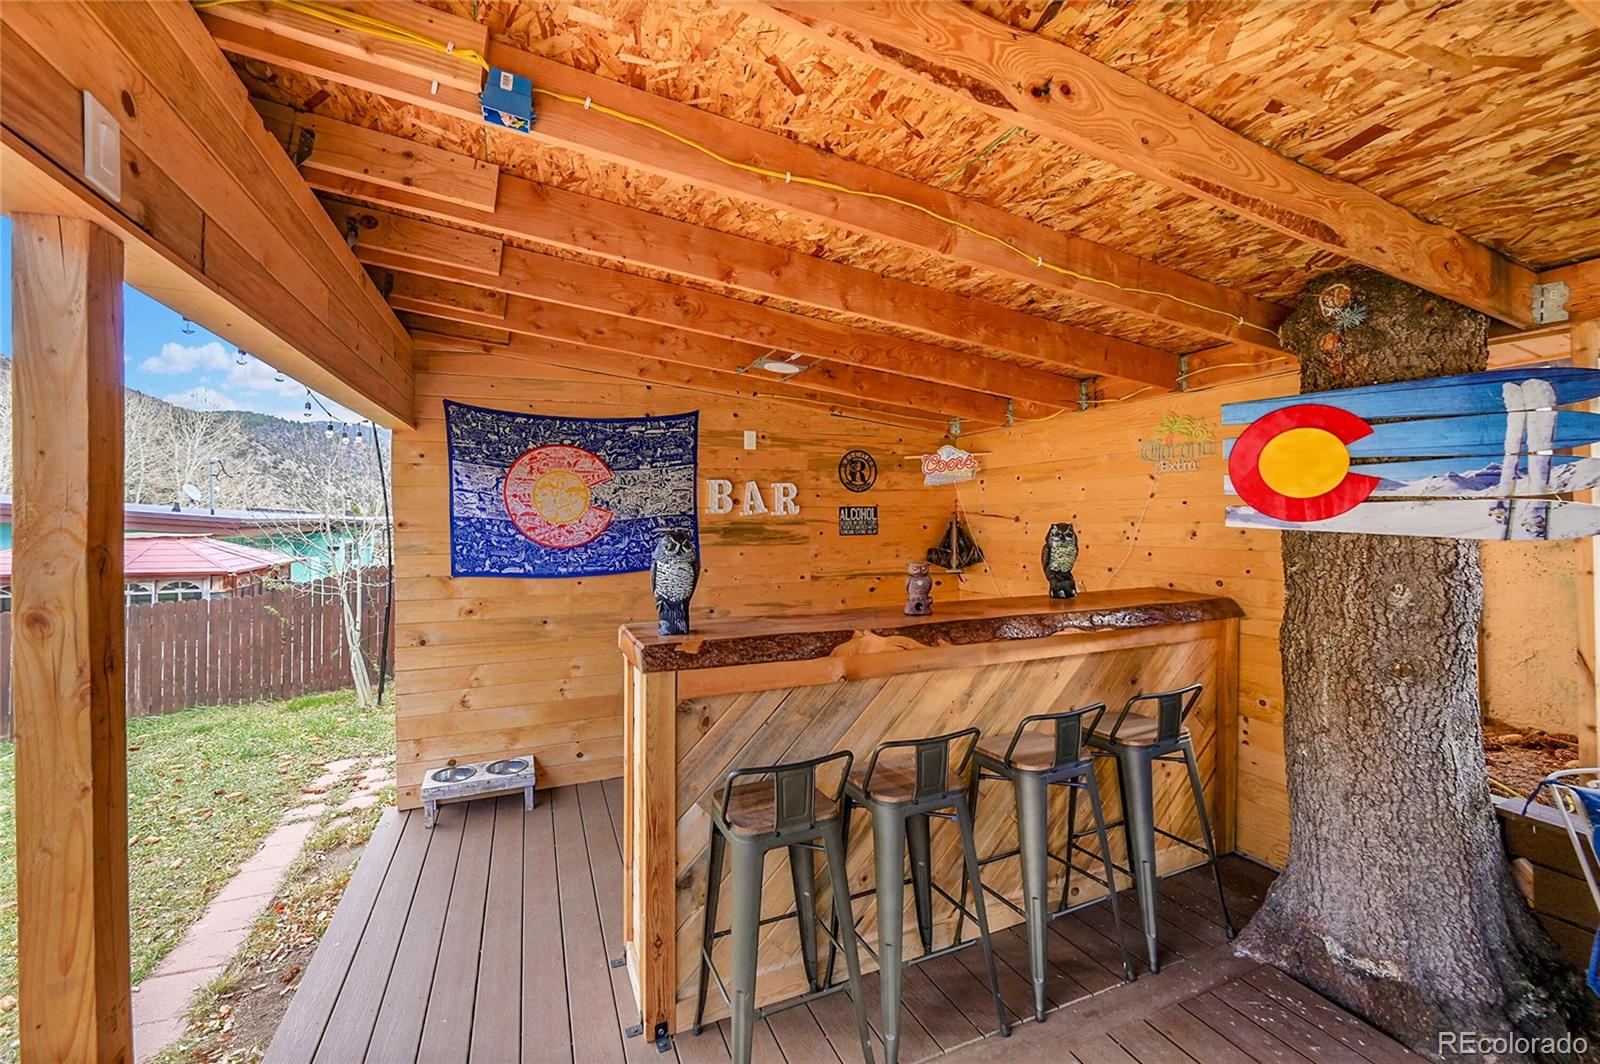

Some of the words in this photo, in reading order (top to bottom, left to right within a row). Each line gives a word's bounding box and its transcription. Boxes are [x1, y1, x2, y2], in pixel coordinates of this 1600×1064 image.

[922, 454, 976, 474] Coors
[705, 479, 800, 516] BAR
[840, 507, 877, 520] ALCOHOL
